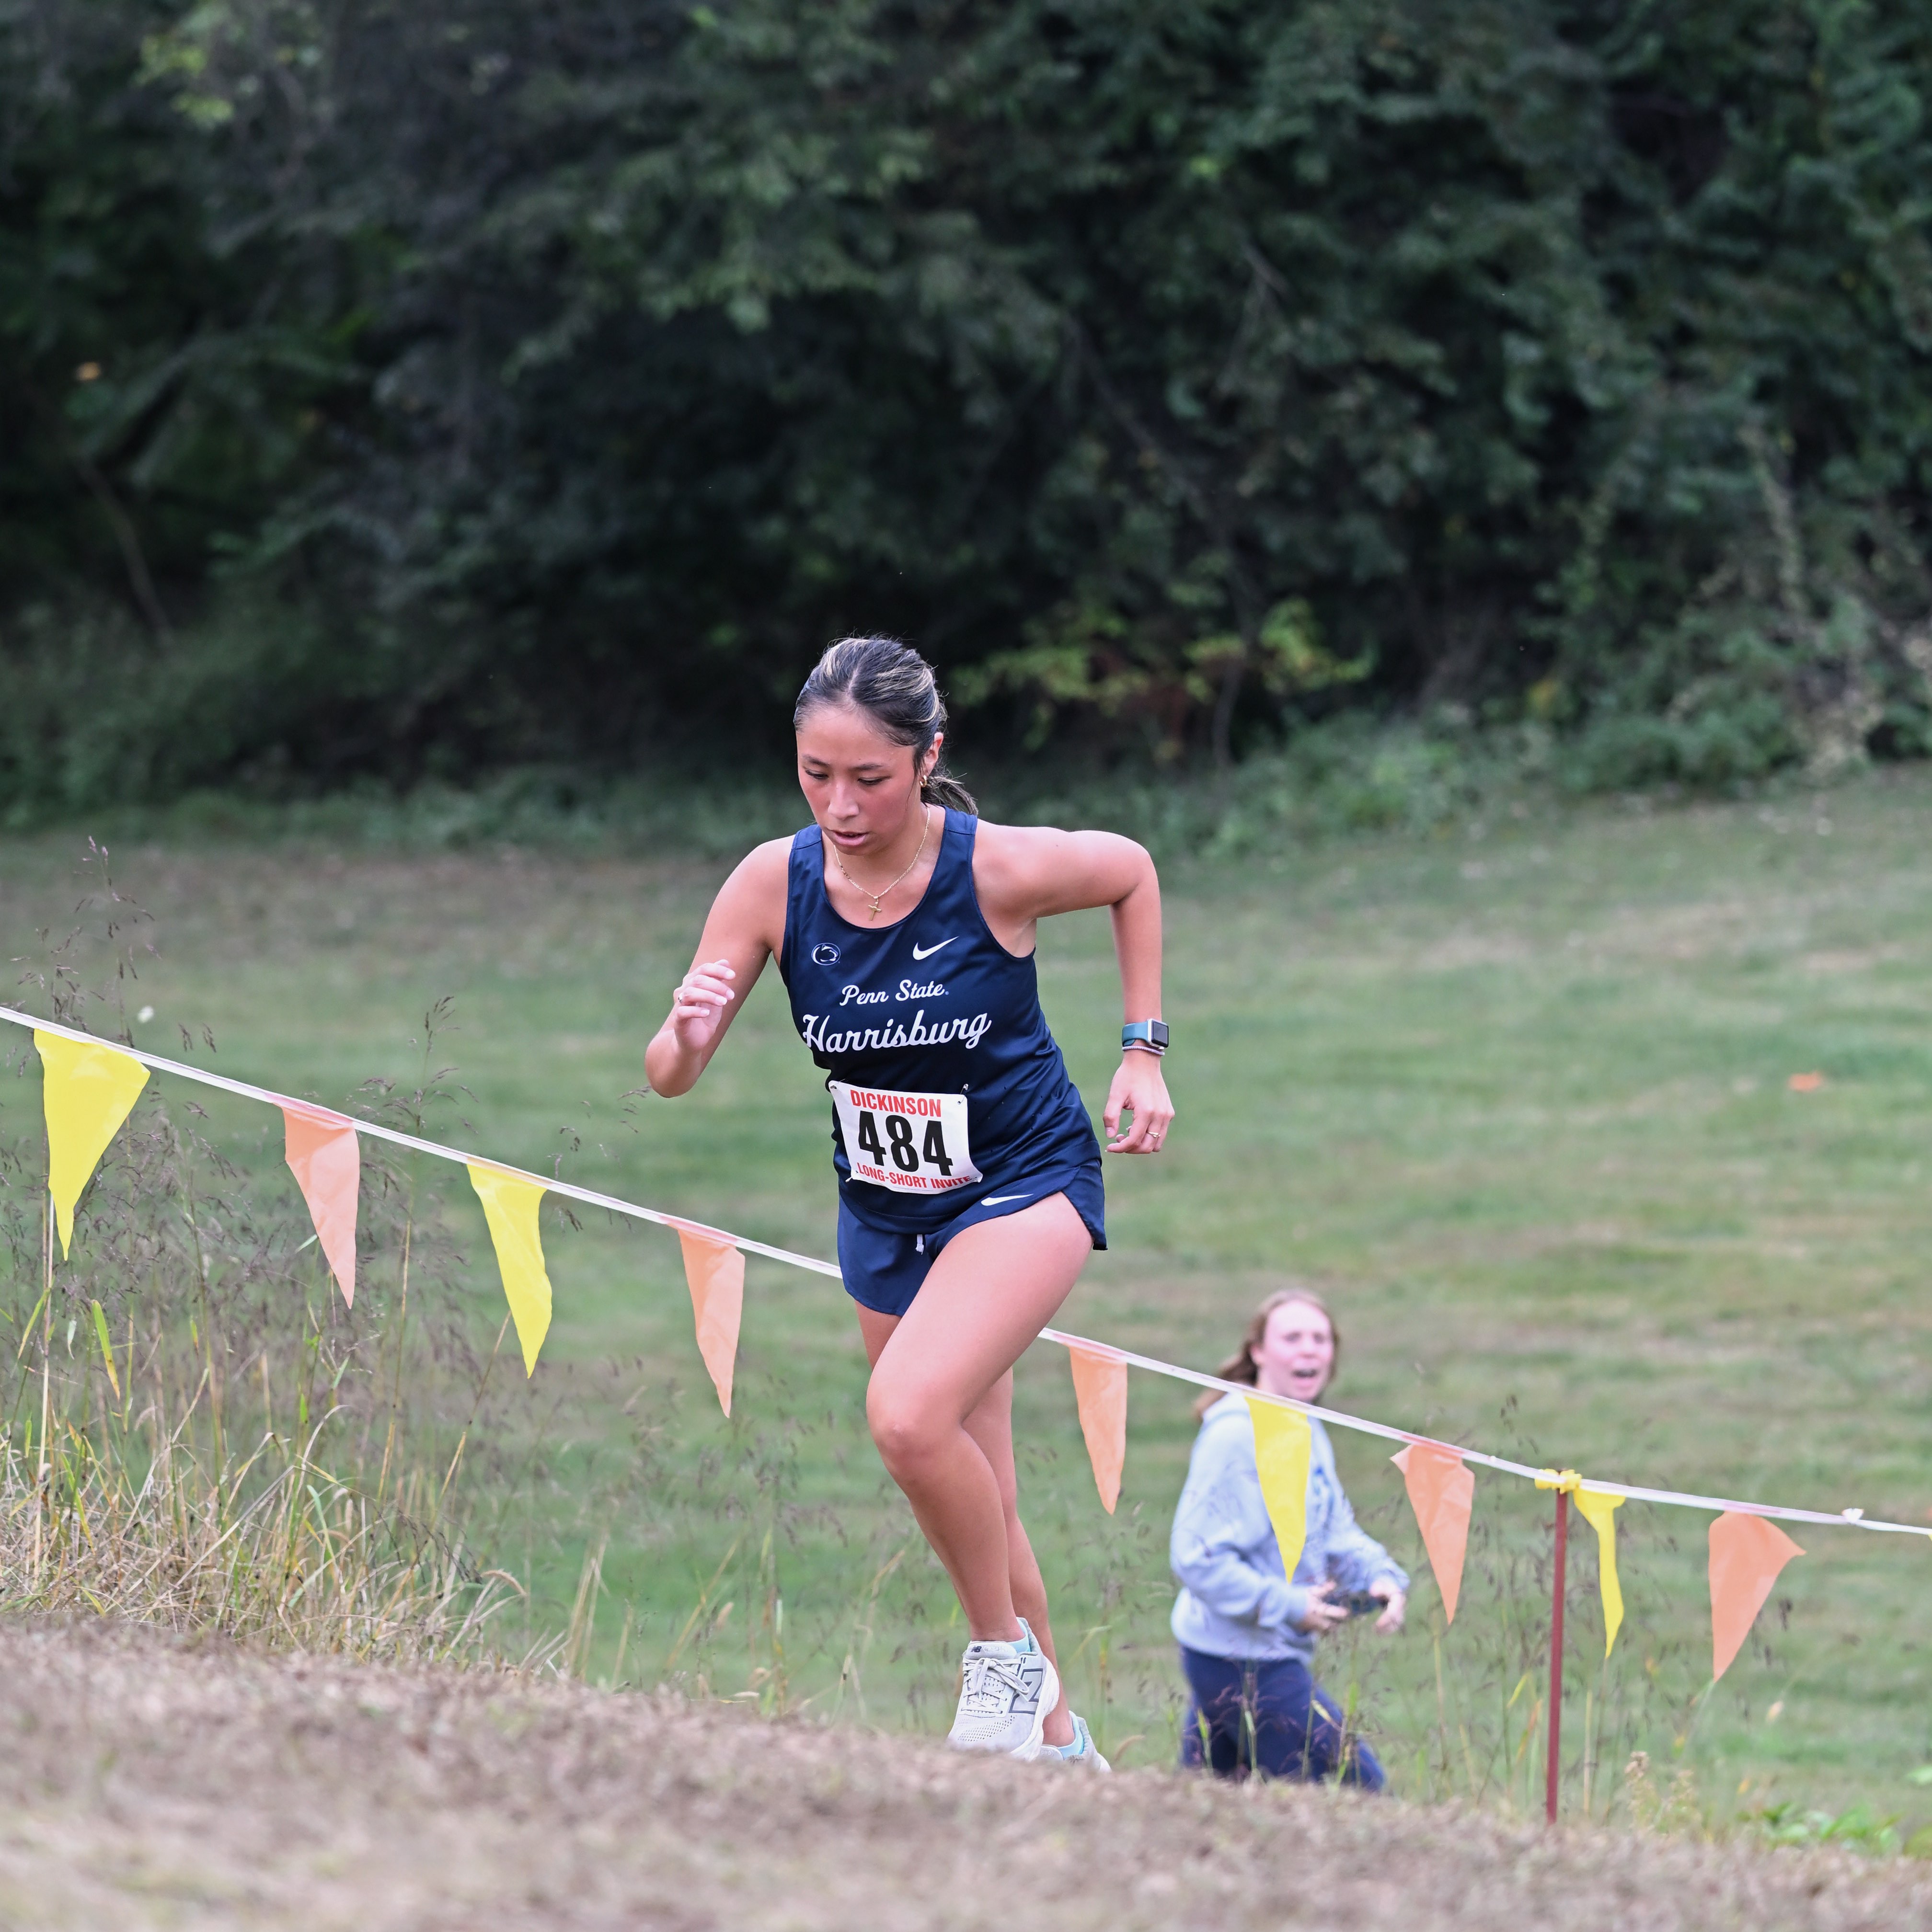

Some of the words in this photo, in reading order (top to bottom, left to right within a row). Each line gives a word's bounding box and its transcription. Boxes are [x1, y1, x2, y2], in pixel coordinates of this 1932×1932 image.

[840, 985, 889, 1006] Penn
[895, 979, 945, 1001] State
[803, 1009, 992, 1053] Harrisburg
[850, 1089, 941, 1117] DICKINSON
[858, 1110, 954, 1176] 484
[857, 1162, 927, 1188] LONG-SHORT
[931, 1176, 972, 1189] INVITE
